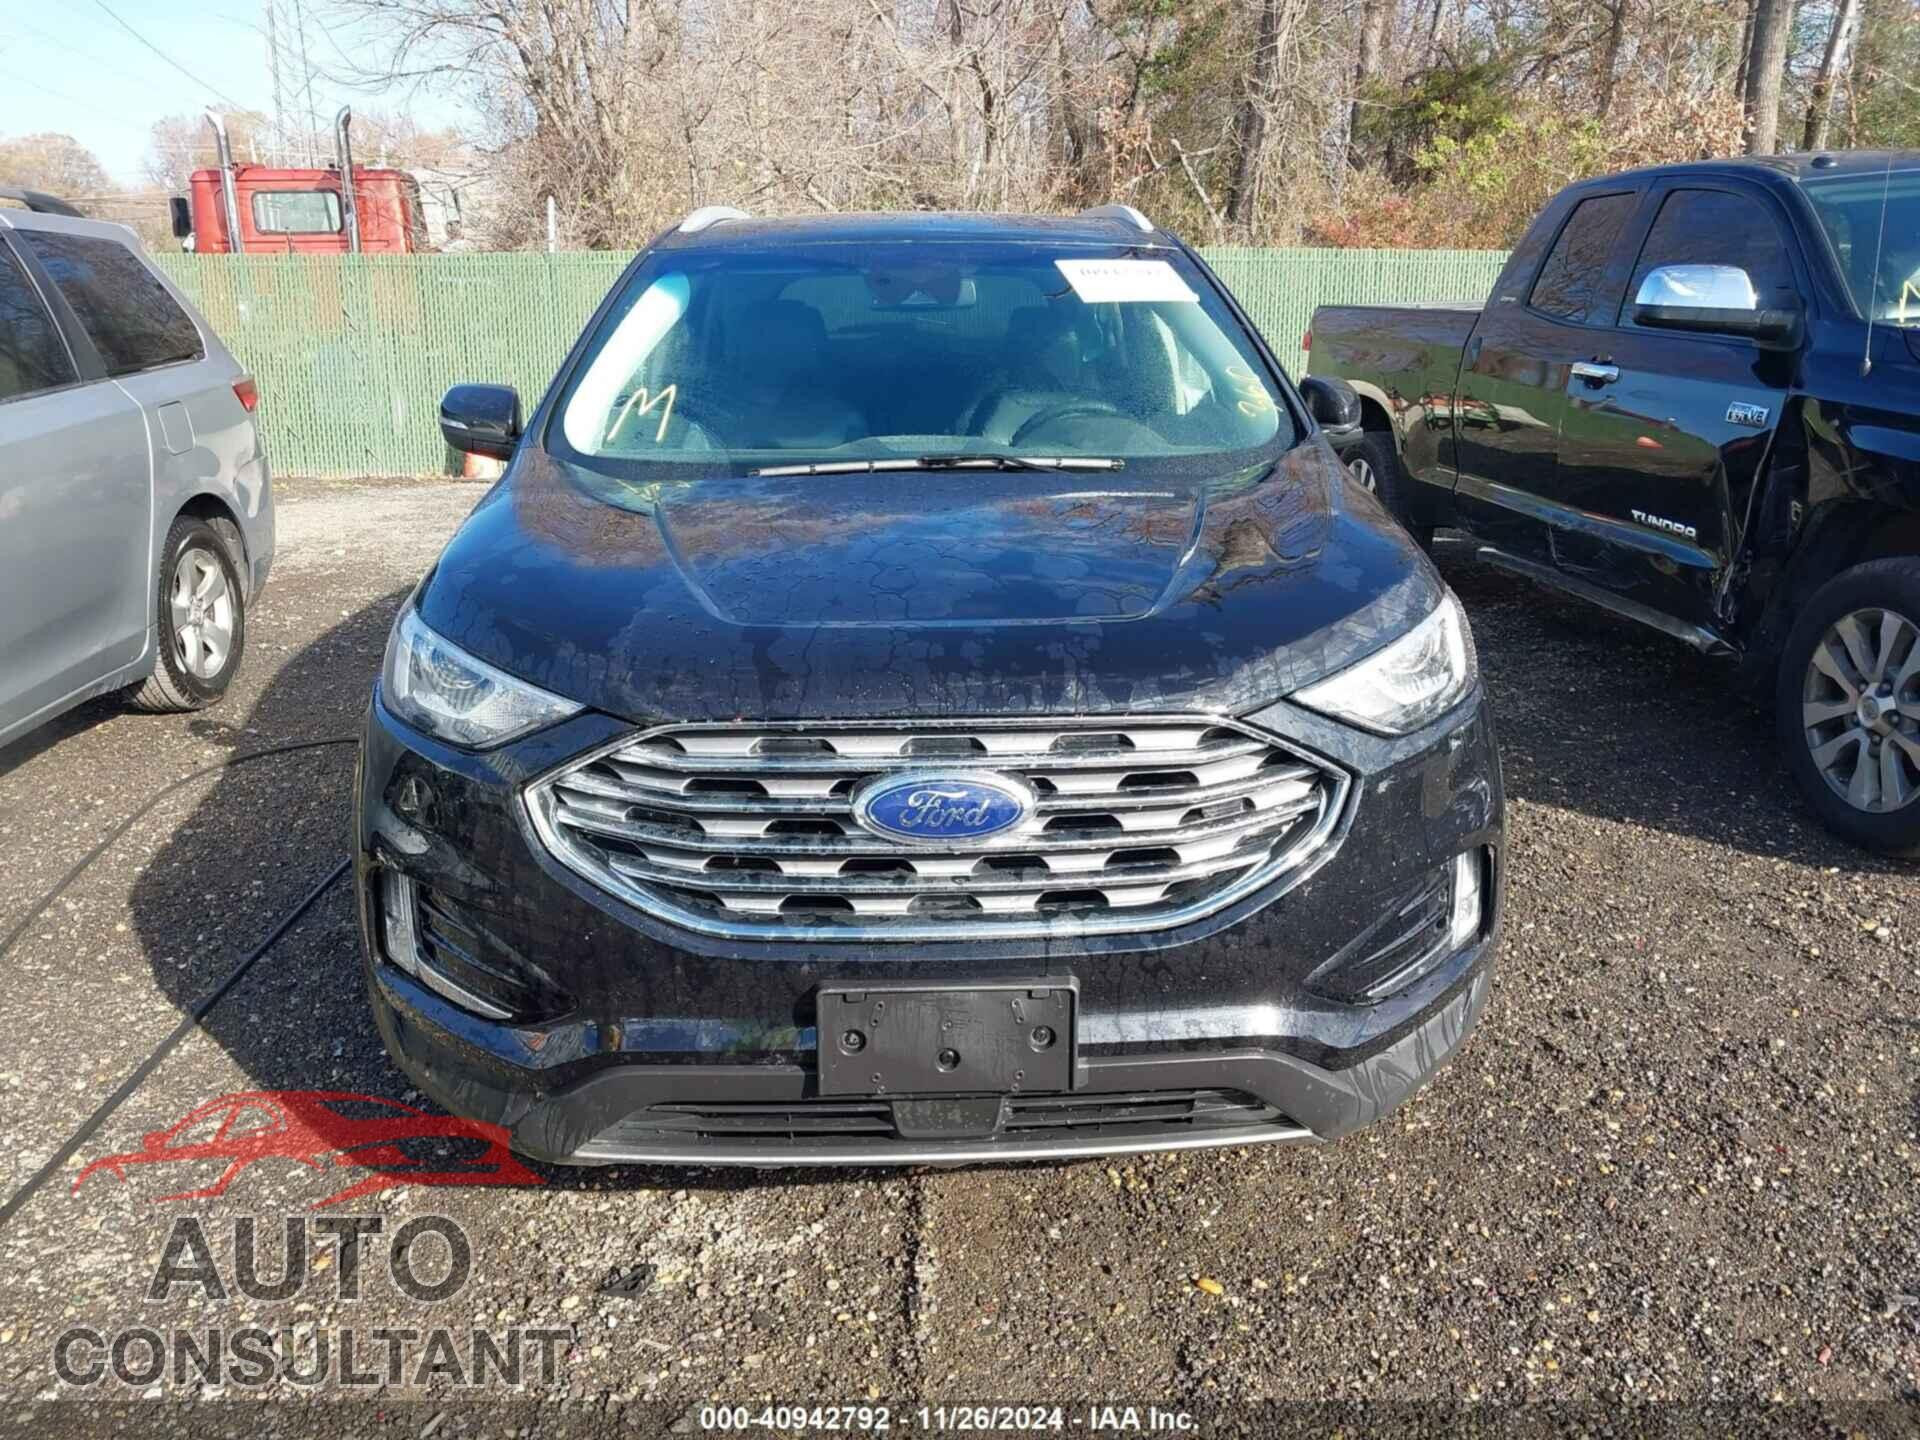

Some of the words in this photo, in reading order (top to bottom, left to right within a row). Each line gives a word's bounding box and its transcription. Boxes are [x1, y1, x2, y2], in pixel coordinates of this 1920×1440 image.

[607, 384, 677, 443] M
[1631, 509, 1697, 538] TUNDRA
[900, 789, 990, 828] Ford
